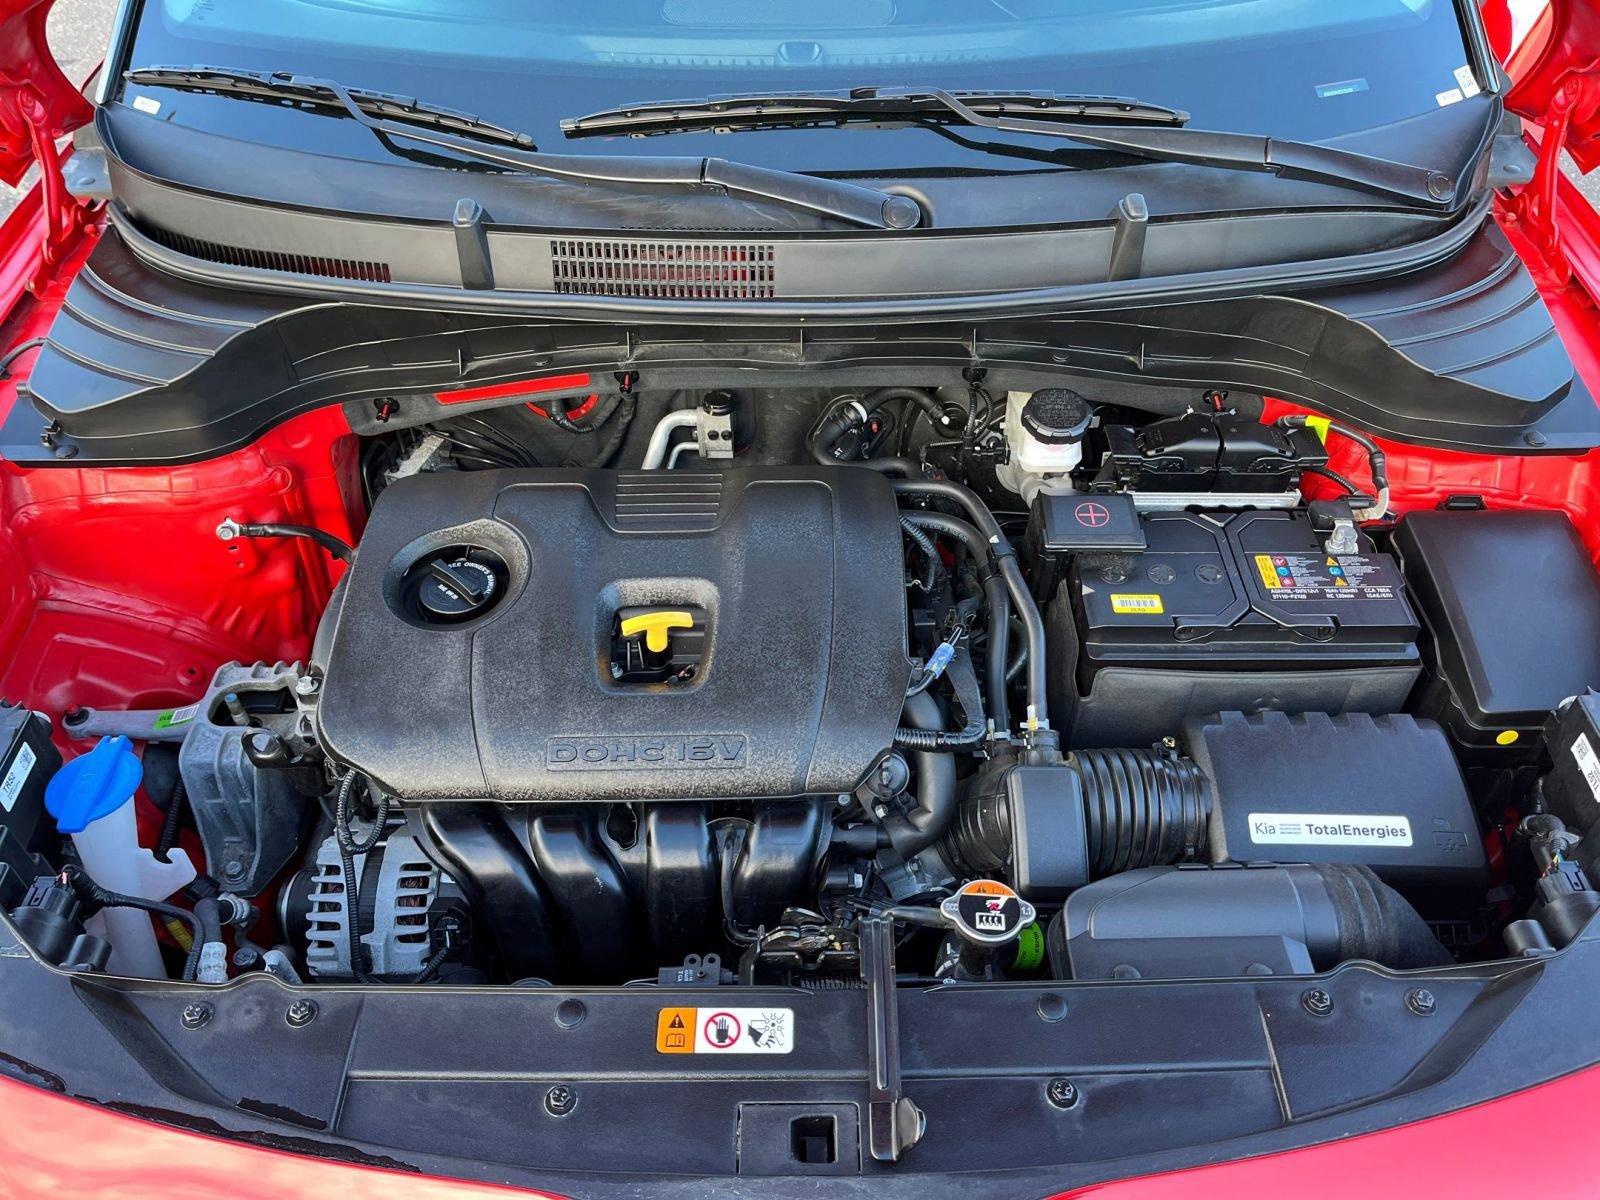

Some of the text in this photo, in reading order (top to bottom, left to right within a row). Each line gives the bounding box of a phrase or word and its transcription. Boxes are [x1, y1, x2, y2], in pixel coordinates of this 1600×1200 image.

[549, 740, 744, 762] DOHC 16V
[1254, 822, 1407, 839] Kia TotalEnergies
